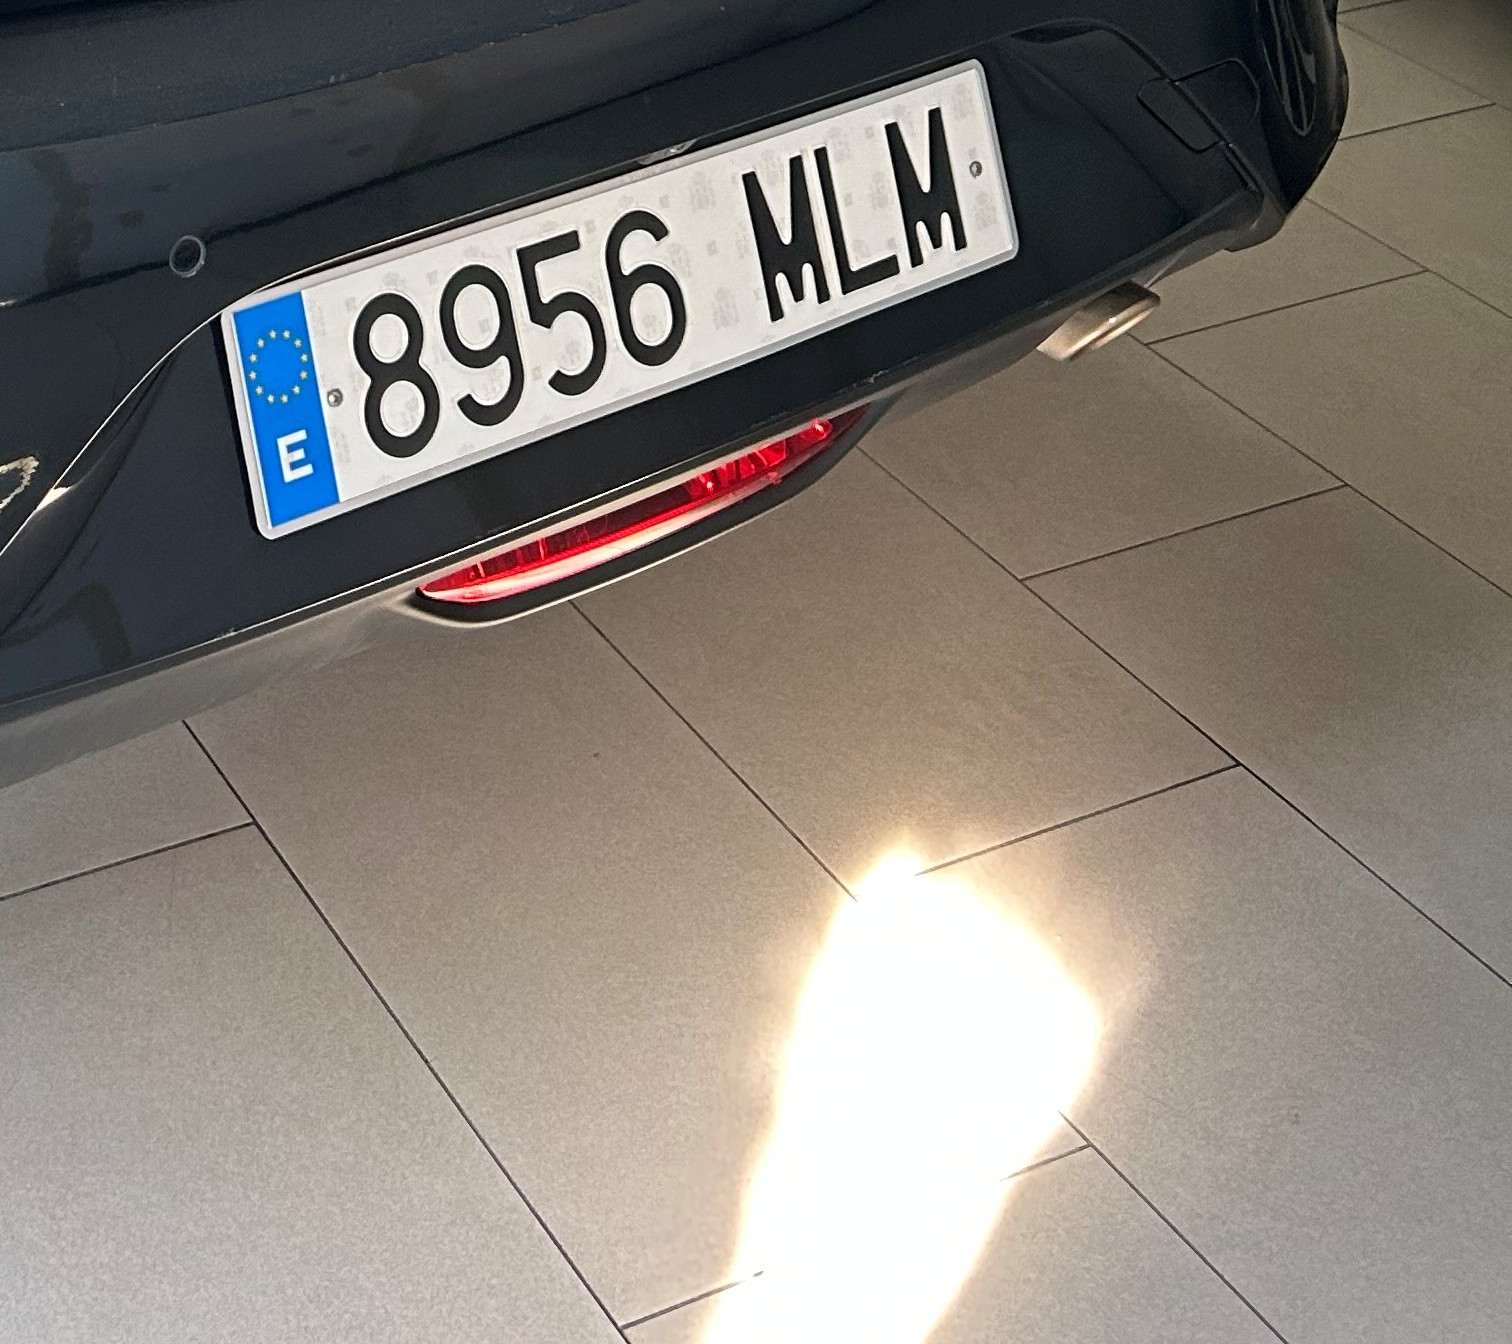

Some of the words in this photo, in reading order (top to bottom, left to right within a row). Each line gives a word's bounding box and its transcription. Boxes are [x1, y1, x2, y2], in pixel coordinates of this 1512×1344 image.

[278, 428, 313, 483] E
[353, 209, 687, 459] 8956
[742, 108, 967, 322] MLM
